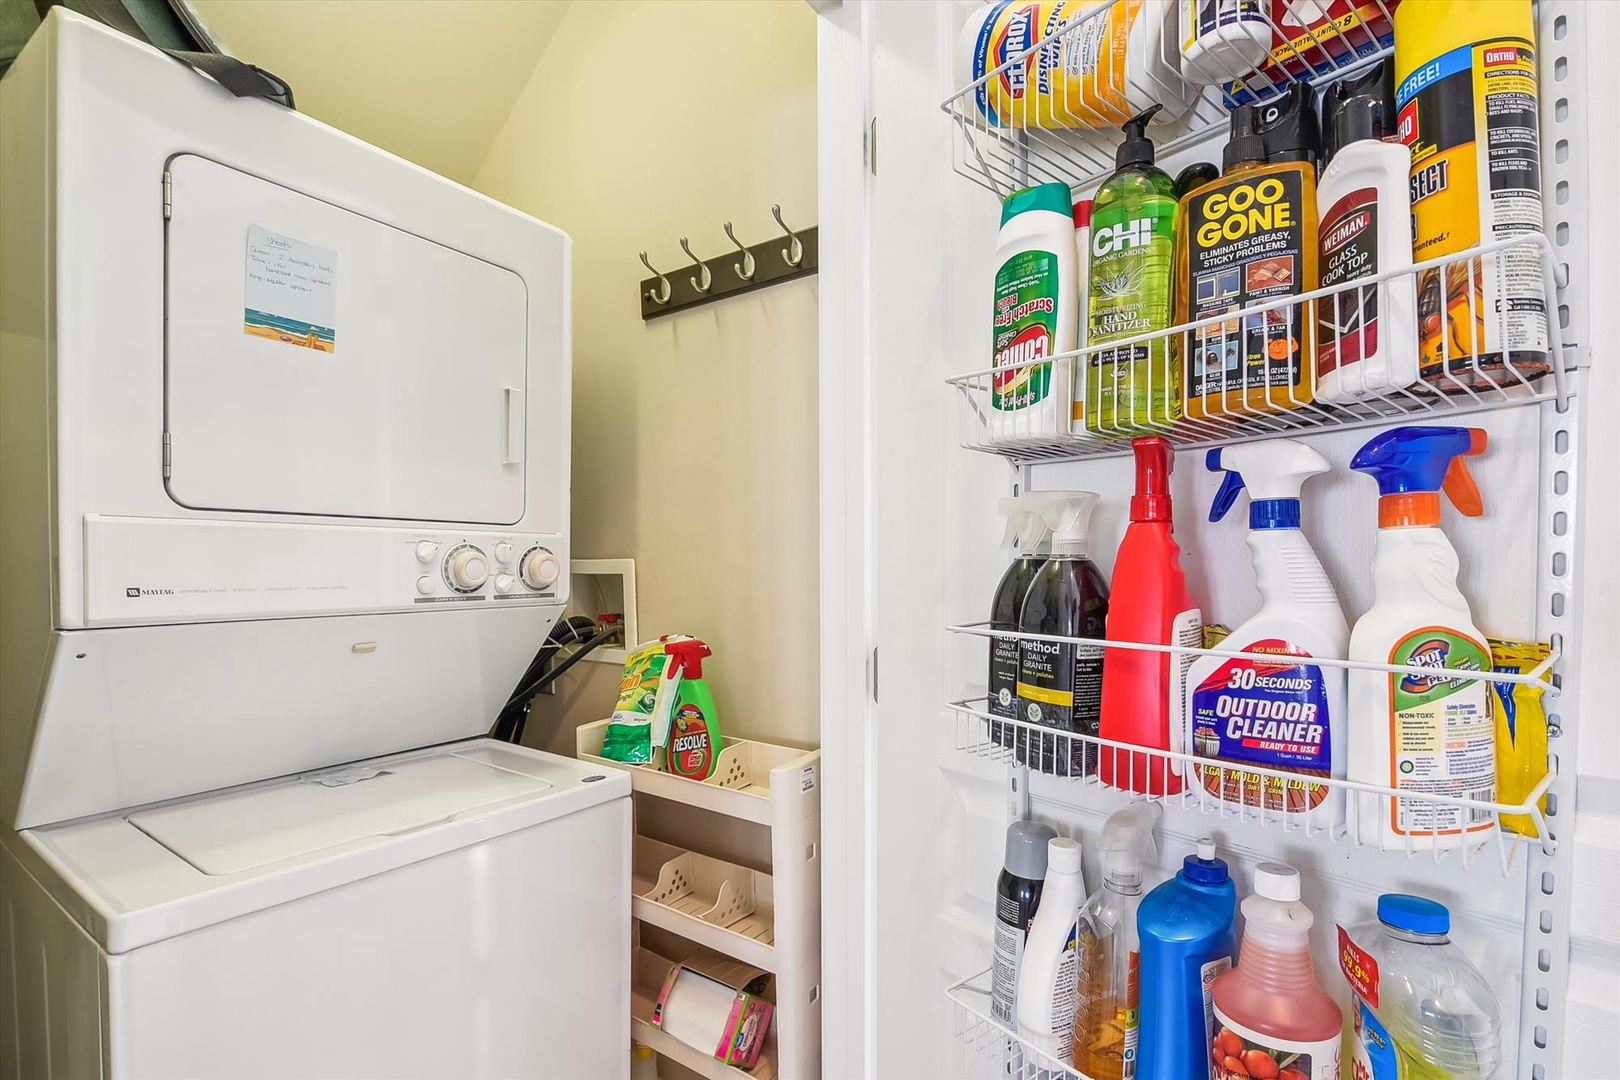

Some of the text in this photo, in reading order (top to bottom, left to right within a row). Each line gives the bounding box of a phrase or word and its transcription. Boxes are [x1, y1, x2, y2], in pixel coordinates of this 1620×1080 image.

[1316, 20, 1342, 36] COUNT
[1343, 15, 1352, 27] 8
[1038, 1, 1067, 94] DISINFCTING
[1048, 19, 1067, 68] WIPS
[1486, 51, 1515, 63] ORTHO
[1404, 62, 1440, 93] FREE!
[1202, 178, 1285, 220] GOO
[1494, 191, 1518, 199] STORAGE
[1197, 202, 1291, 247] GONE
[1093, 217, 1151, 257] CHI
[1200, 231, 1291, 260] ELIMINATES GREASY,
[278, 253, 284, 261] 2
[1093, 247, 1152, 268] ORGANIC GARDENS
[1203, 241, 1287, 268] STICKY PROBLEMS
[1328, 244, 1358, 270] GLASS
[1211, 262, 1236, 272] MANCHAS
[1321, 264, 1344, 287] COOK
[1347, 251, 1369, 271] TOP
[1346, 269, 1360, 280] heavy
[1360, 263, 1372, 275] duty
[998, 293, 1018, 310] Bleach
[1096, 302, 1147, 316] MOISTURIZING
[995, 298, 1054, 327] Scratch Free
[1104, 311, 1137, 324] HAND
[1092, 318, 1151, 337] SANITIZER
[1252, 326, 1269, 334] GREA
[995, 335, 1049, 379] Comet
[1246, 353, 1261, 361] itrus
[142, 588, 174, 596] MAYTAG
[995, 648, 1018, 659] GRANITE
[999, 642, 1015, 650] DAILY
[1021, 640, 1060, 655] method
[1028, 652, 1047, 661] DAILY
[1406, 649, 1441, 667] SPOT
[1024, 660, 1052, 672] GRANITE
[1036, 671, 1054, 679] polishes
[1227, 667, 1313, 690] 30 SECONDS
[1198, 695, 1318, 722] SAFE OUTDOOR
[1226, 716, 1323, 744] CLEANER
[672, 733, 708, 753] RESOLVE
[1260, 741, 1316, 754] READY TO USE
[1199, 765, 1229, 779] LGAE,
[1264, 775, 1271, 785] &
[1273, 778, 1320, 792] MLDEW
[1346, 943, 1360, 963] KILLS
[1343, 949, 1370, 984] 99.9%
